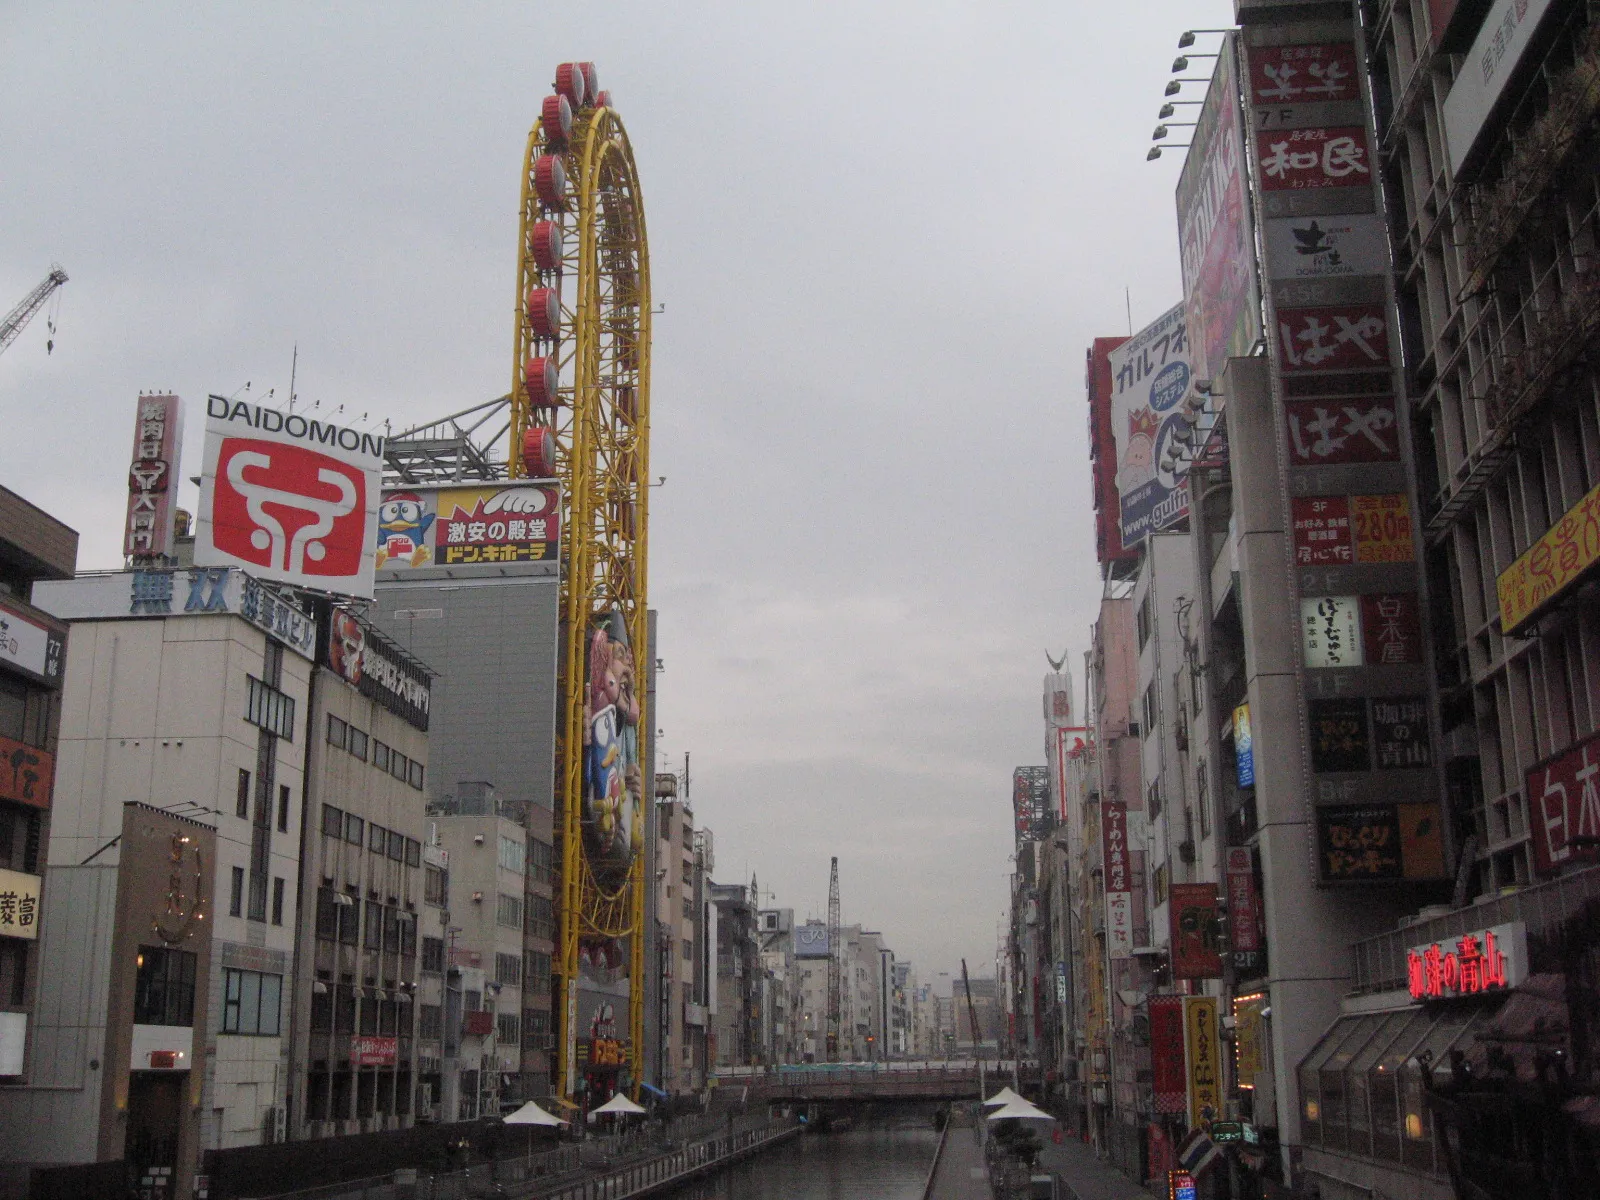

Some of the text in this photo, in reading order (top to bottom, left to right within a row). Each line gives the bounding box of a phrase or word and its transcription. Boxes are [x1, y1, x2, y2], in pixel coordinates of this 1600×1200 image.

[1260, 136, 1370, 180] 和民
[207, 394, 384, 458] DAIDOMON
[448, 519, 547, 543] 激安の殿堂
[1376, 595, 1409, 663] 白木屋
[1407, 930, 1505, 999] 珈琲の青山
